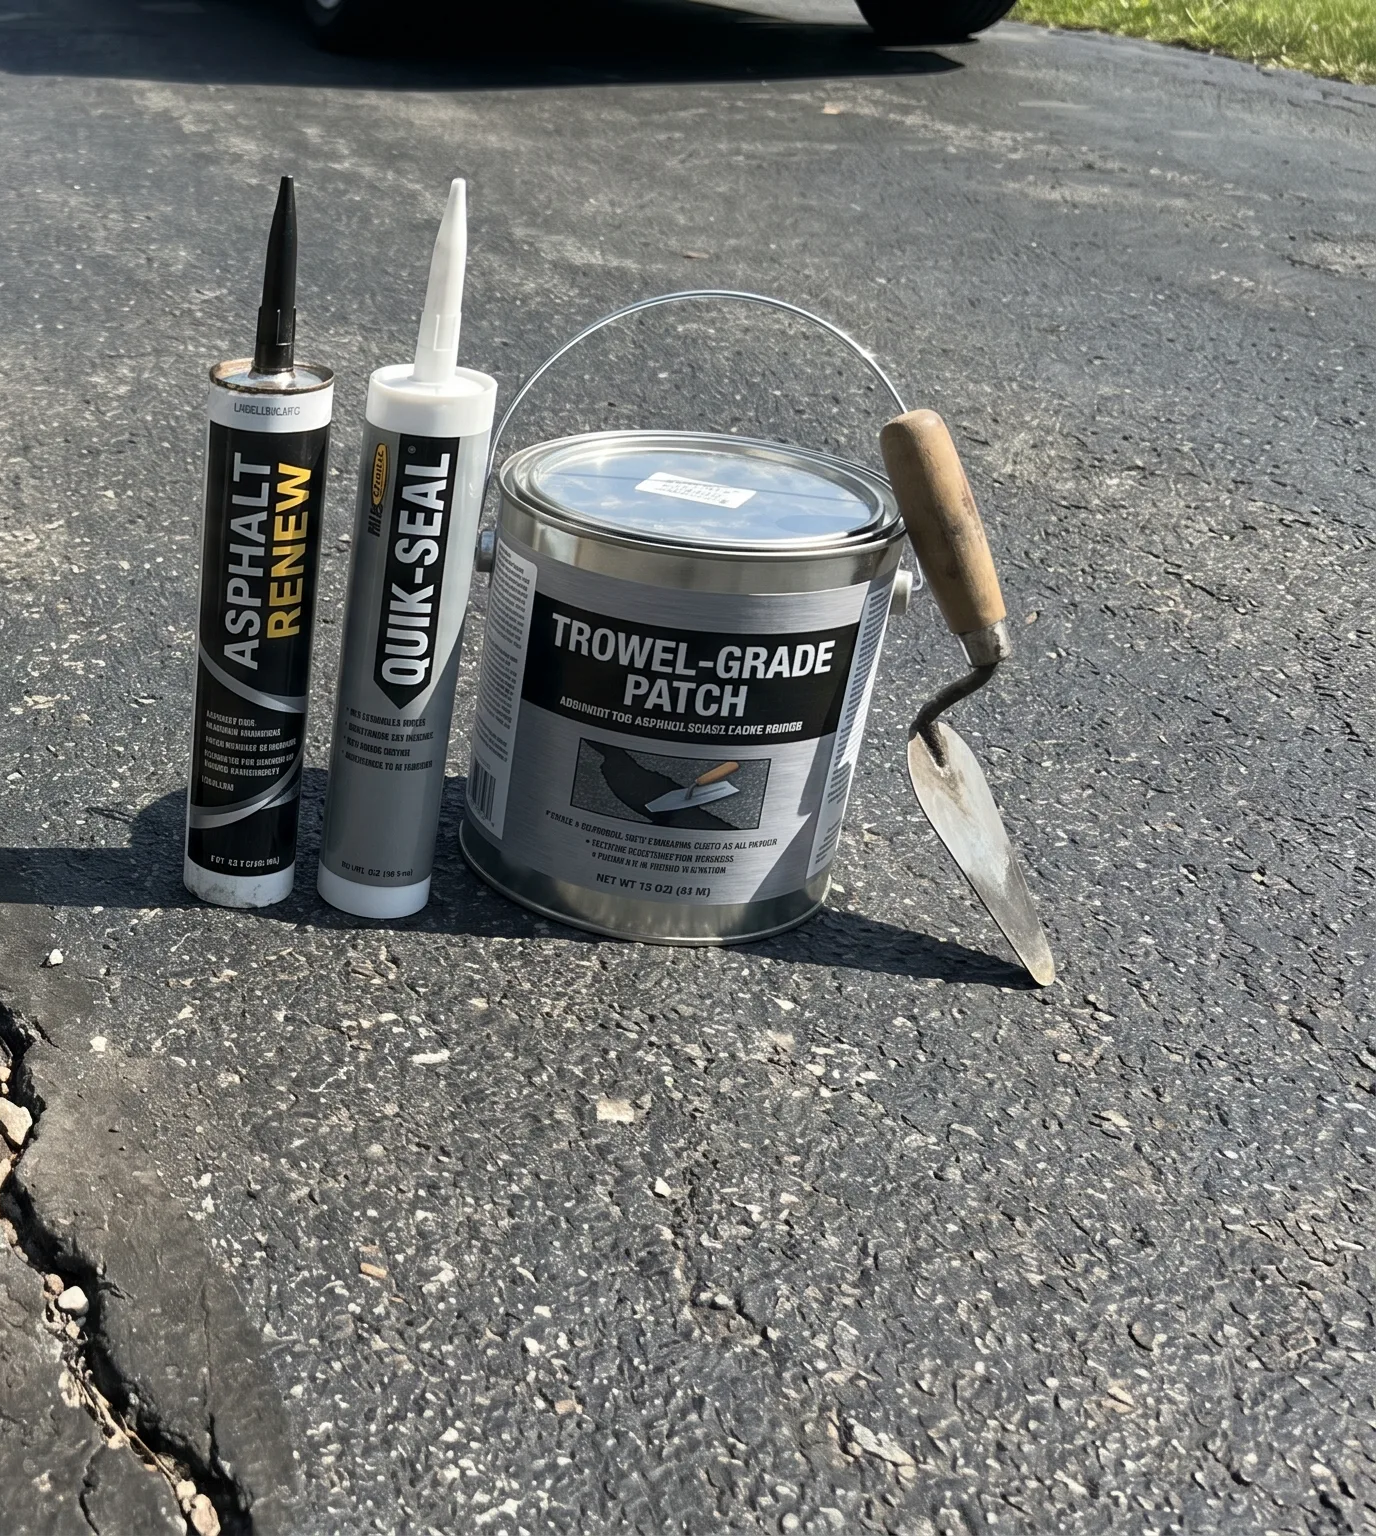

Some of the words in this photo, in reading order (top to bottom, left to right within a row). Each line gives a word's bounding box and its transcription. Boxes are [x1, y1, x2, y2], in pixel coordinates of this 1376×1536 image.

[223, 452, 271, 671] ASPHALT
[266, 462, 312, 640] RENEW
[381, 453, 451, 685] QUIK-SEAL
[552, 612, 836, 680] TROWEL-GRADE
[623, 673, 748, 718] PATCH
[596, 873, 617, 885] NET
[619, 878, 637, 889] WT
